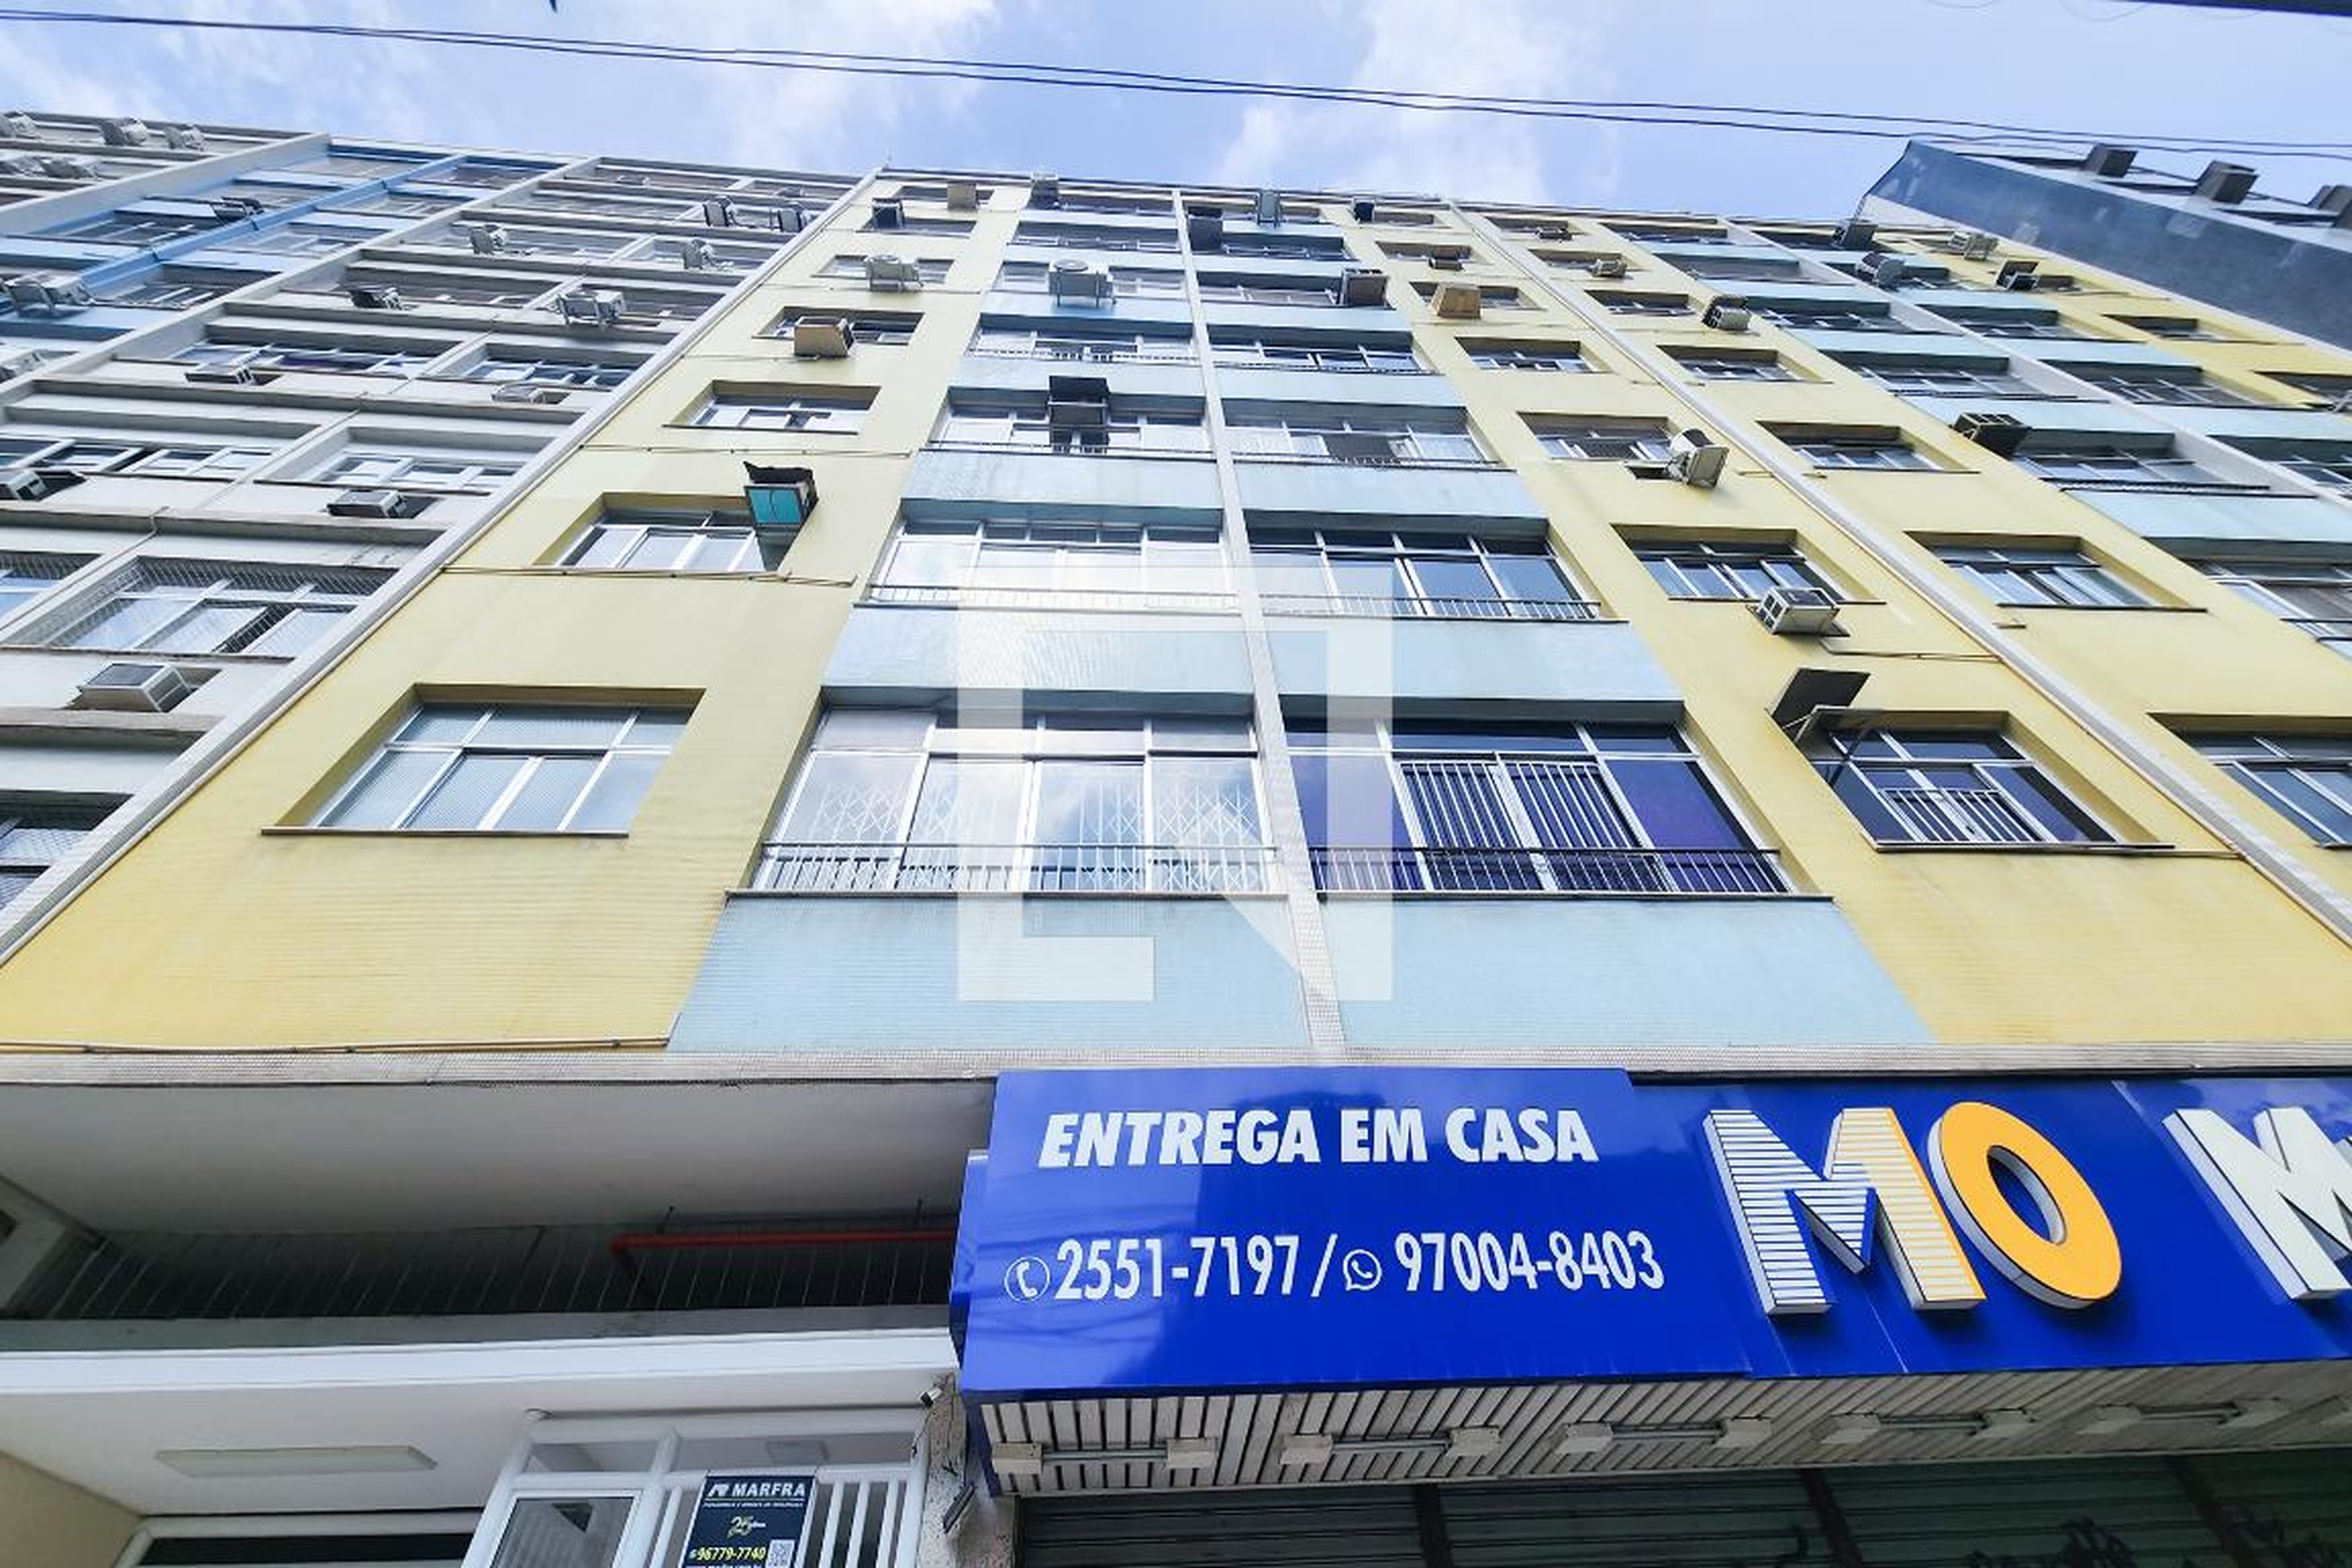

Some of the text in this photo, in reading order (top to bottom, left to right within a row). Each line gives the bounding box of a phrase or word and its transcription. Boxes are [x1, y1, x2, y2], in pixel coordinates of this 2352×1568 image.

[1038, 1108, 1598, 1167] ENTREGA EM CASA
[1702, 1101, 2352, 1314] MO M
[1054, 1235, 1299, 1299] 2551-7197
[1395, 1231, 1664, 1291] 97004-8403
[732, 1483, 805, 1497] MARFRA
